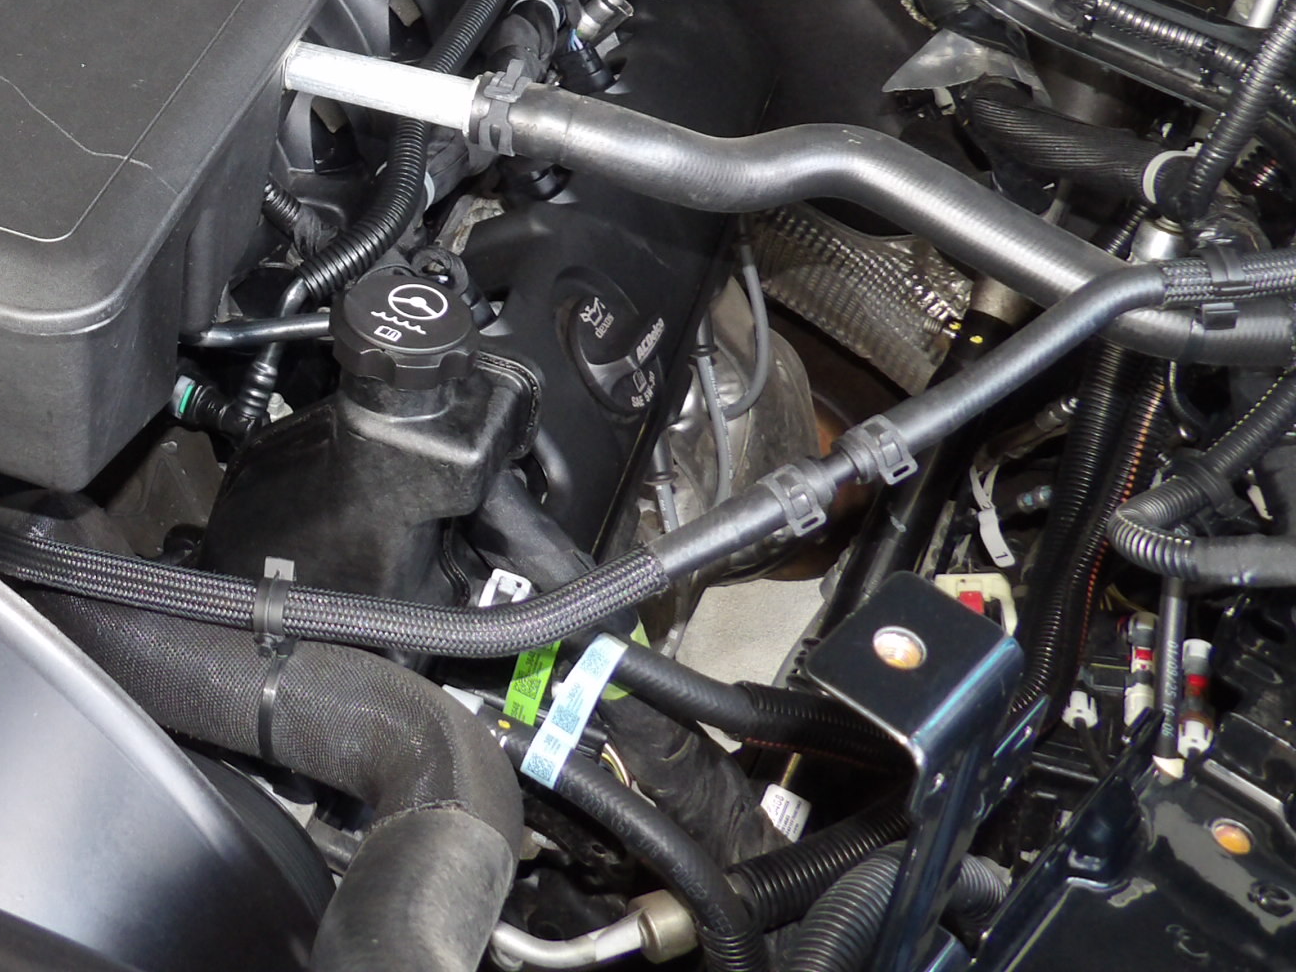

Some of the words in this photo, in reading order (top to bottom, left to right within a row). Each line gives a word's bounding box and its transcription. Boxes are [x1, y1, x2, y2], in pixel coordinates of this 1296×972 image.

[595, 312, 615, 339] dexos
[636, 317, 664, 359] ACDelco
[631, 395, 645, 408] SAE
[1166, 641, 1179, 699] 01/09/25
[671, 861, 709, 900] POWER
